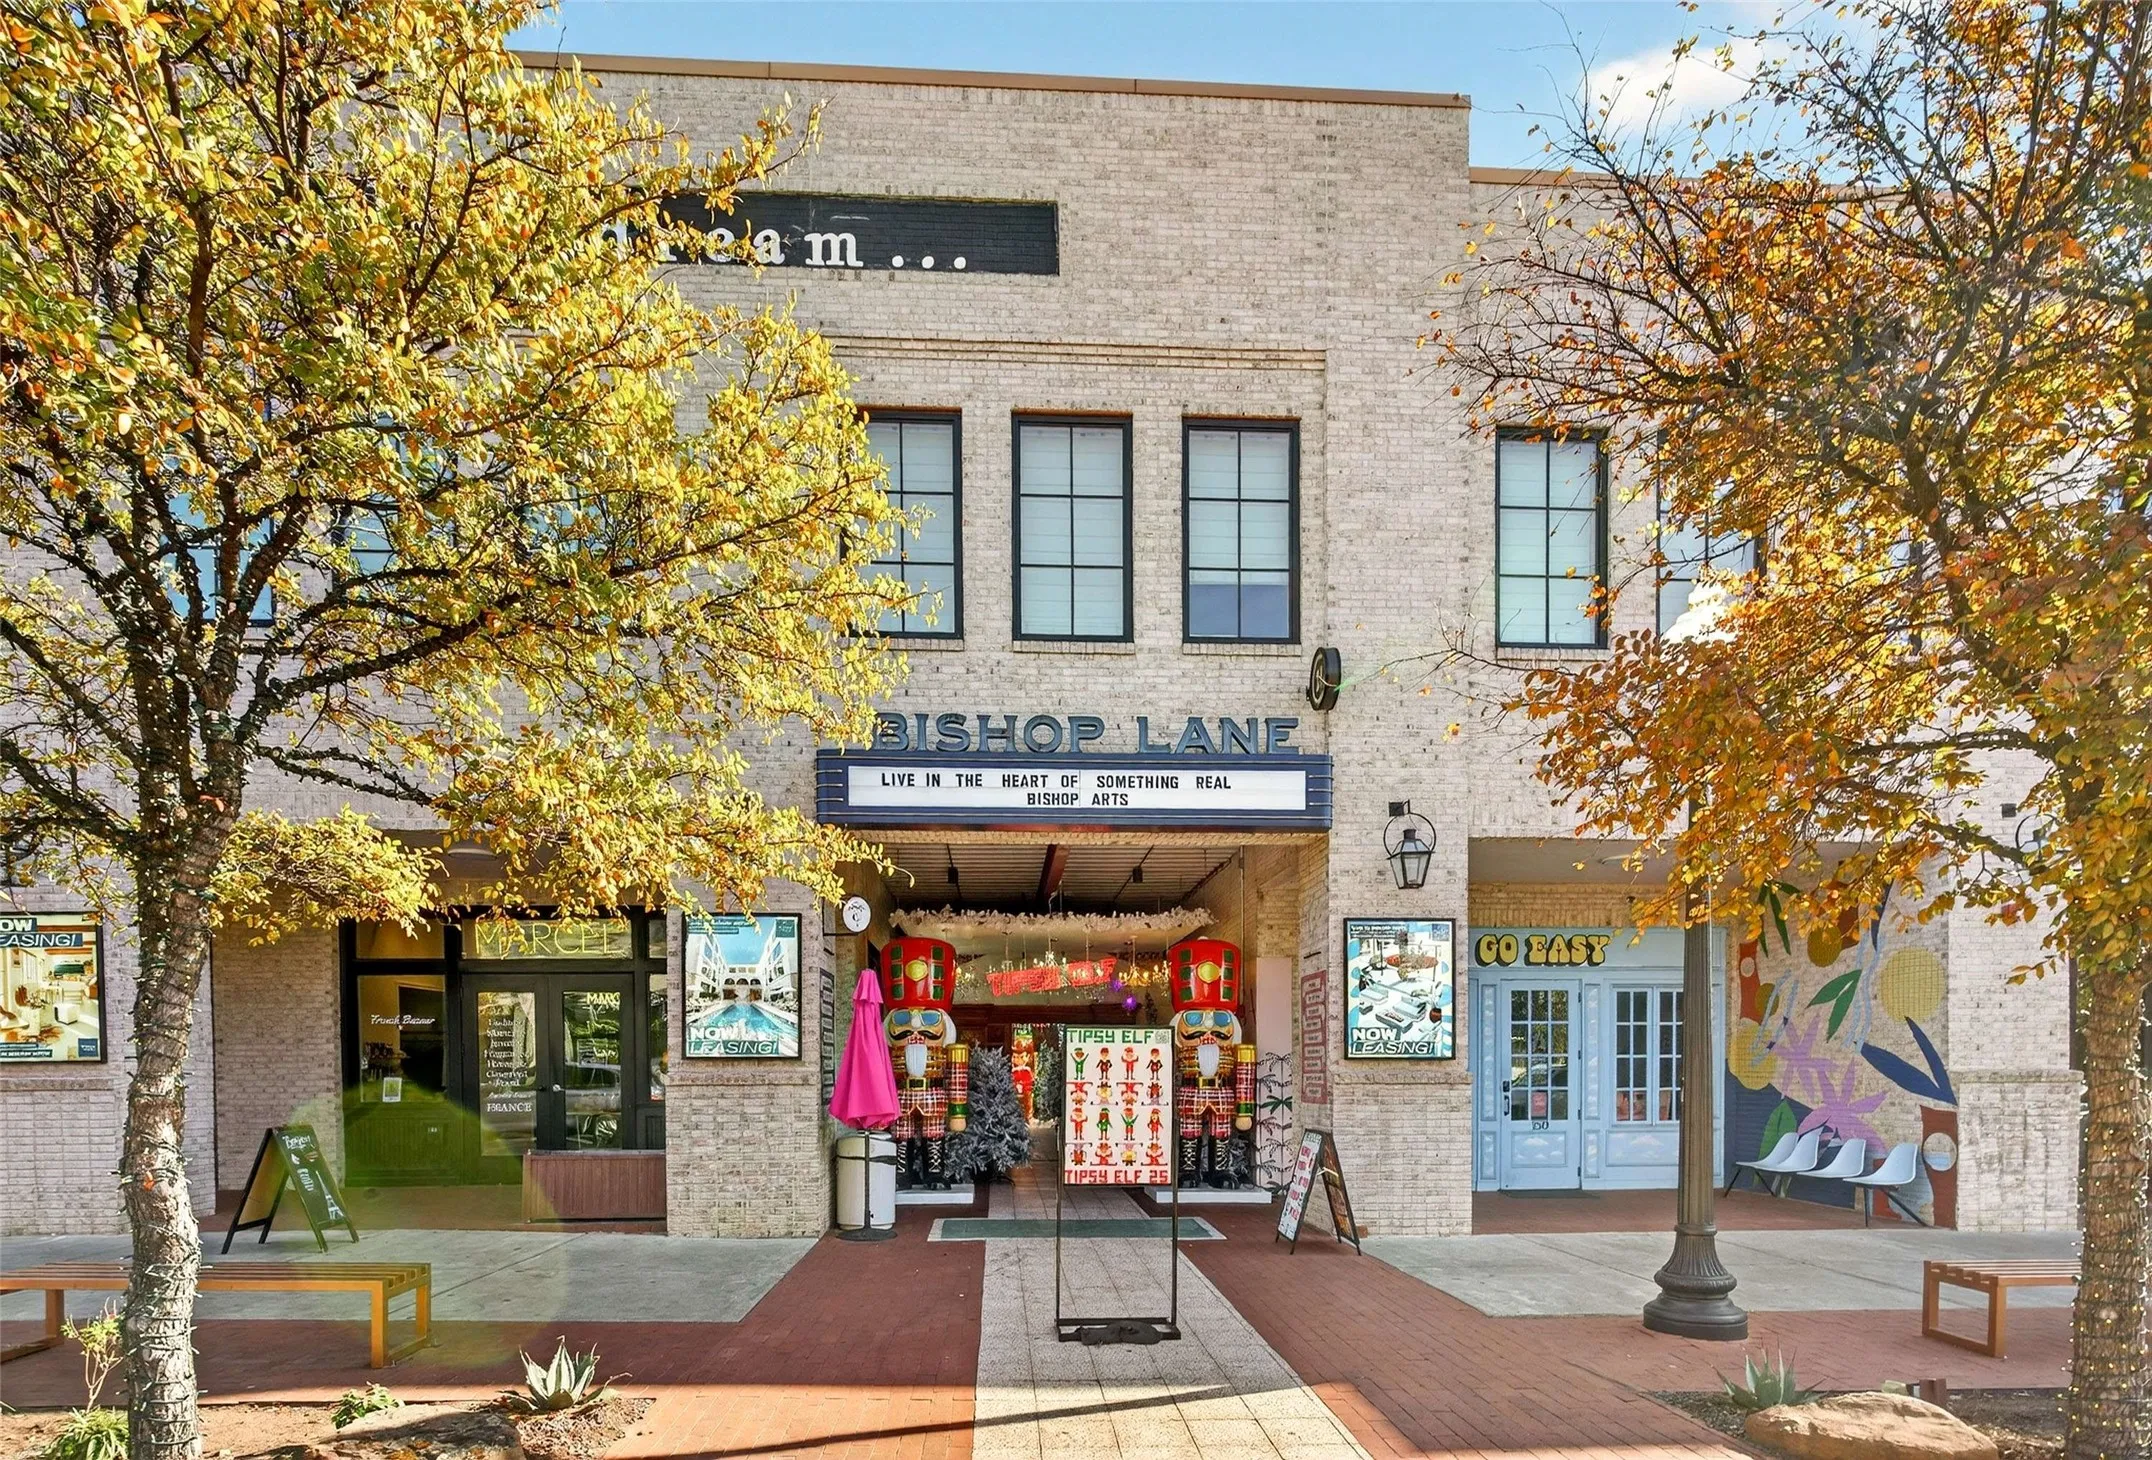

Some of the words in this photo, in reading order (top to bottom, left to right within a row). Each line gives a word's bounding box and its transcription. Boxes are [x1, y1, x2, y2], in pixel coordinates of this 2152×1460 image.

[872, 712, 1105, 754] BISHOP
[1136, 715, 1300, 755] LANE
[881, 772, 916, 788] LIVE
[926, 772, 941, 788] IN
[955, 773, 983, 788] THE
[1002, 773, 1049, 788] HEART
[1061, 774, 1079, 788] OF
[1096, 774, 1179, 790] SOMETHING
[1196, 776, 1232, 790] REAL
[1027, 792, 1079, 806] BISHOP
[1091, 793, 1129, 807] ARTS
[474, 923, 624, 955] MRCEL
[1475, 934, 1519, 967] GO
[1524, 934, 1611, 967] EASY
[1067, 1030, 1116, 1044] TIPSY
[1121, 1030, 1154, 1044] ELF
[1352, 1028, 1398, 1041] NOW
[689, 1040, 778, 1055] LEASING!
[1352, 1041, 1435, 1055] LEASING!
[1064, 1169, 1108, 1184] TIPSY
[1114, 1169, 1143, 1184] ELF
[1149, 1169, 1169, 1184] 25
